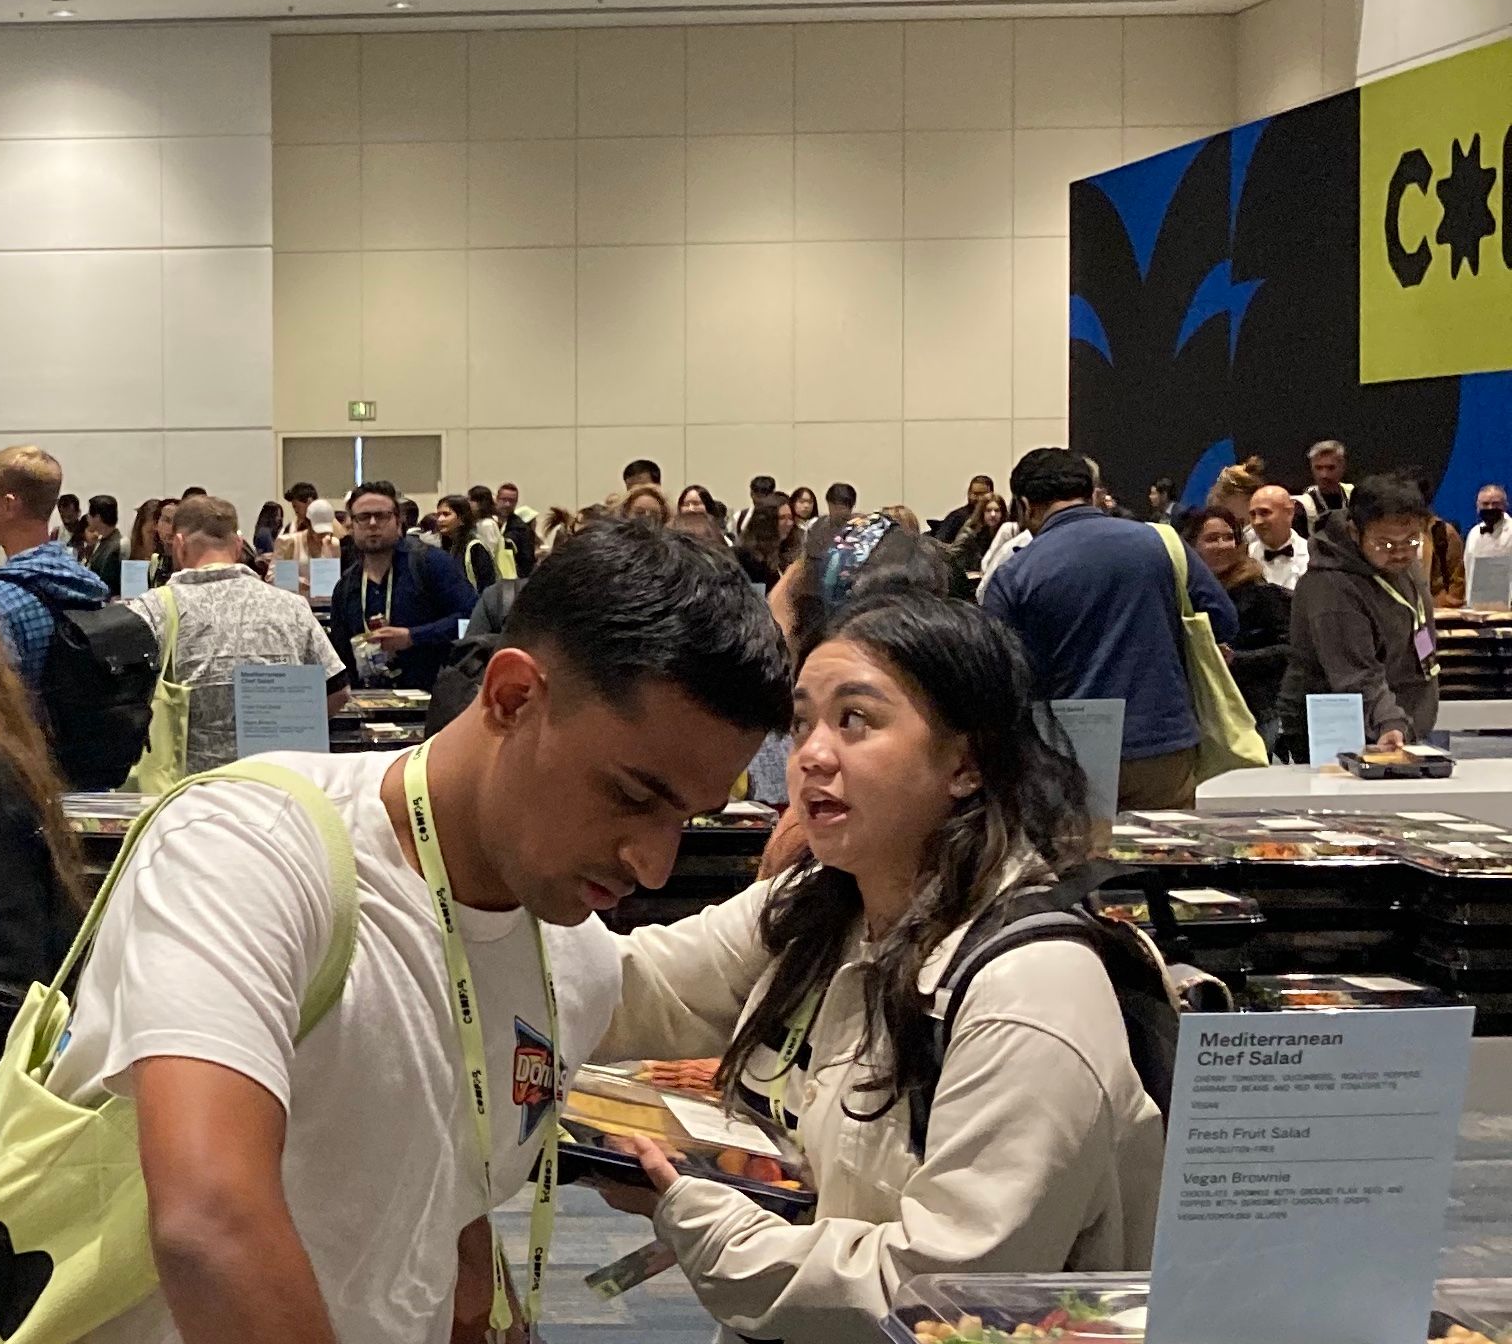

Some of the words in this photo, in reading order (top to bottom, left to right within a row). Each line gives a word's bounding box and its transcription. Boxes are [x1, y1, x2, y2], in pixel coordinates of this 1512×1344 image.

[1200, 1032, 1343, 1046] Mediterranean
[1198, 1051, 1244, 1066] Chef
[1249, 1050, 1303, 1065] Salad
[1188, 1128, 1228, 1140] Fresh
[1233, 1128, 1266, 1139] Fruit
[1272, 1127, 1311, 1139] Salad
[1183, 1173, 1226, 1186] Vegan
[1232, 1172, 1291, 1183] Brownie
